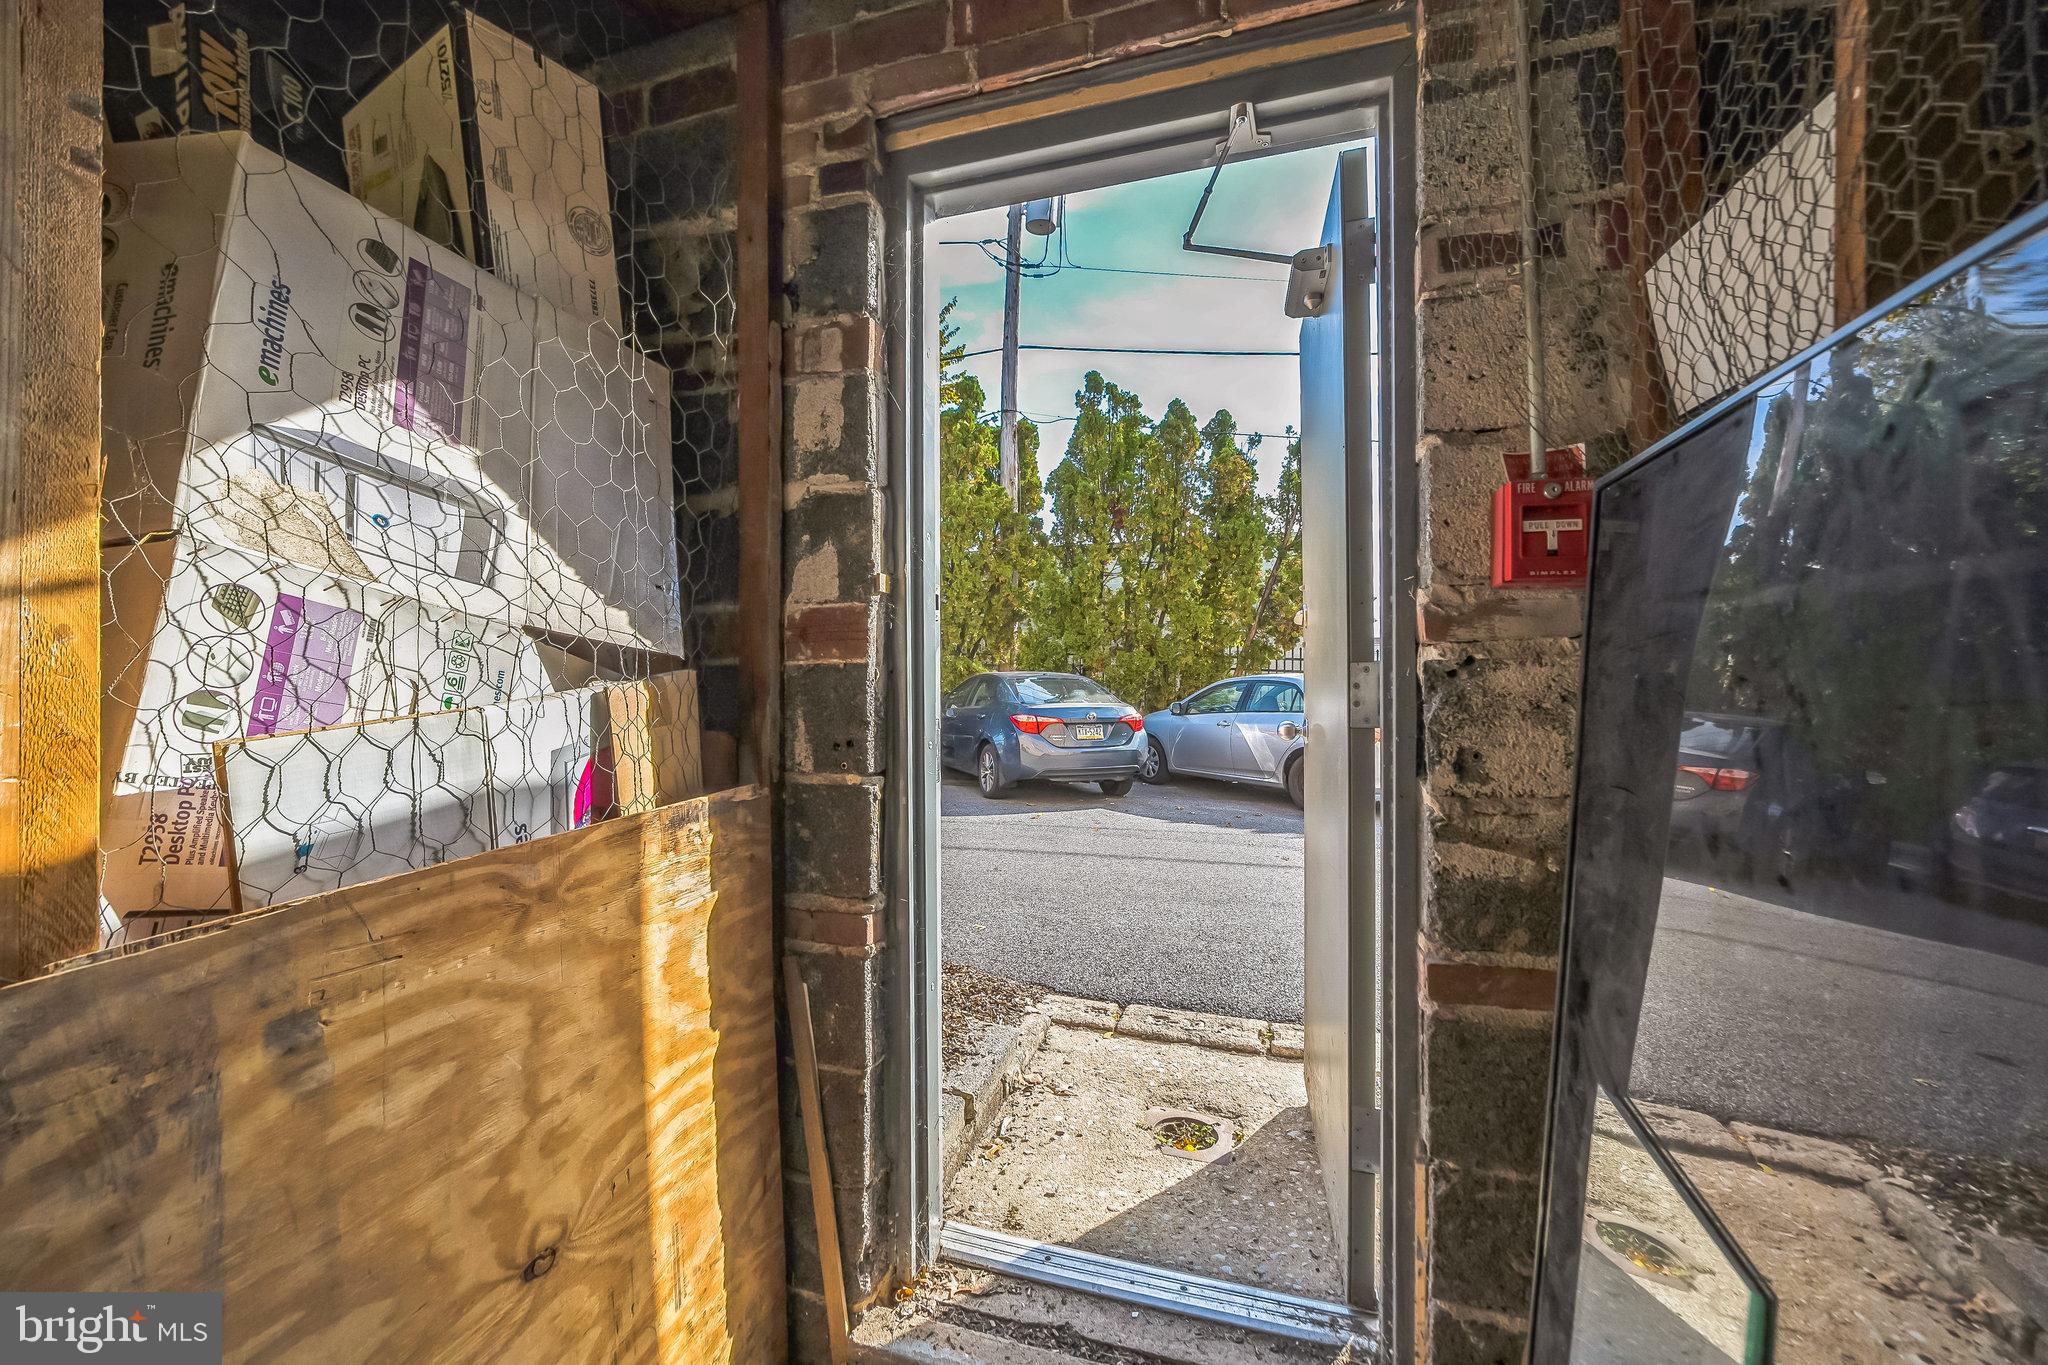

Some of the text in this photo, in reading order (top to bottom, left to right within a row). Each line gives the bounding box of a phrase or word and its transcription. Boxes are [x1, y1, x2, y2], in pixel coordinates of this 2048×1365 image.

[258, 279, 291, 386] emachines
[358, 354, 372, 371] PC
[338, 371, 355, 404] T2958
[1517, 480, 1594, 494] FIRE ALARM
[1528, 520, 1579, 530] PULL DOWN
[138, 812, 168, 866] T2958
[165, 798, 198, 866] Desktop
[188, 816, 204, 850] Amplified
[199, 812, 215, 851] Multimedia
[185, 850, 196, 866] Plus
[196, 851, 206, 866] and
